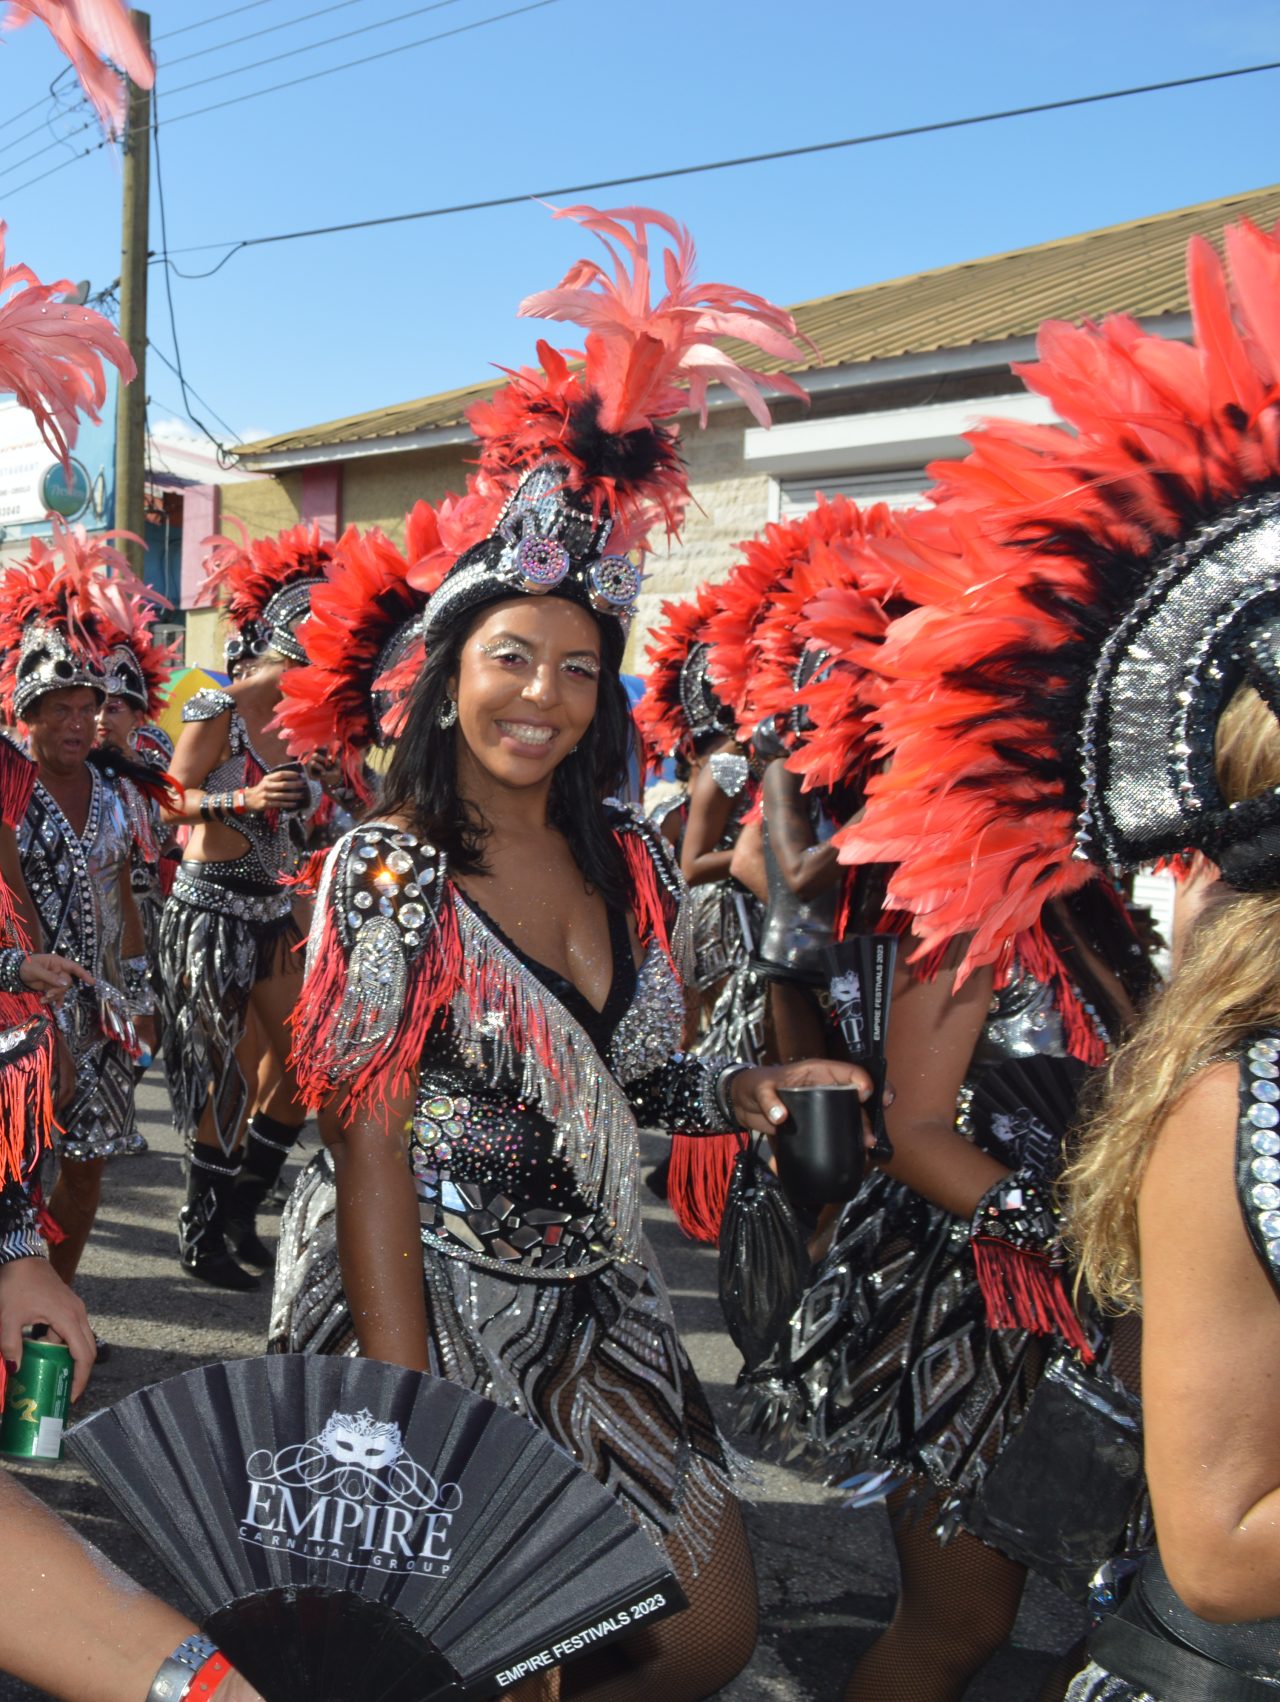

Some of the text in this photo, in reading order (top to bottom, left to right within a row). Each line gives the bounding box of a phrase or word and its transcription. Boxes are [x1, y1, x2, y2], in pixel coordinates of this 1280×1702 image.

[873, 944, 884, 1041] EMPIRE FESTIVALS 2023
[238, 1526, 451, 1574] CARNIVAL GROUP
[241, 1479, 453, 1561] EMPIRE
[495, 1593, 666, 1687] EMPIRE FESTIVALS 2023
